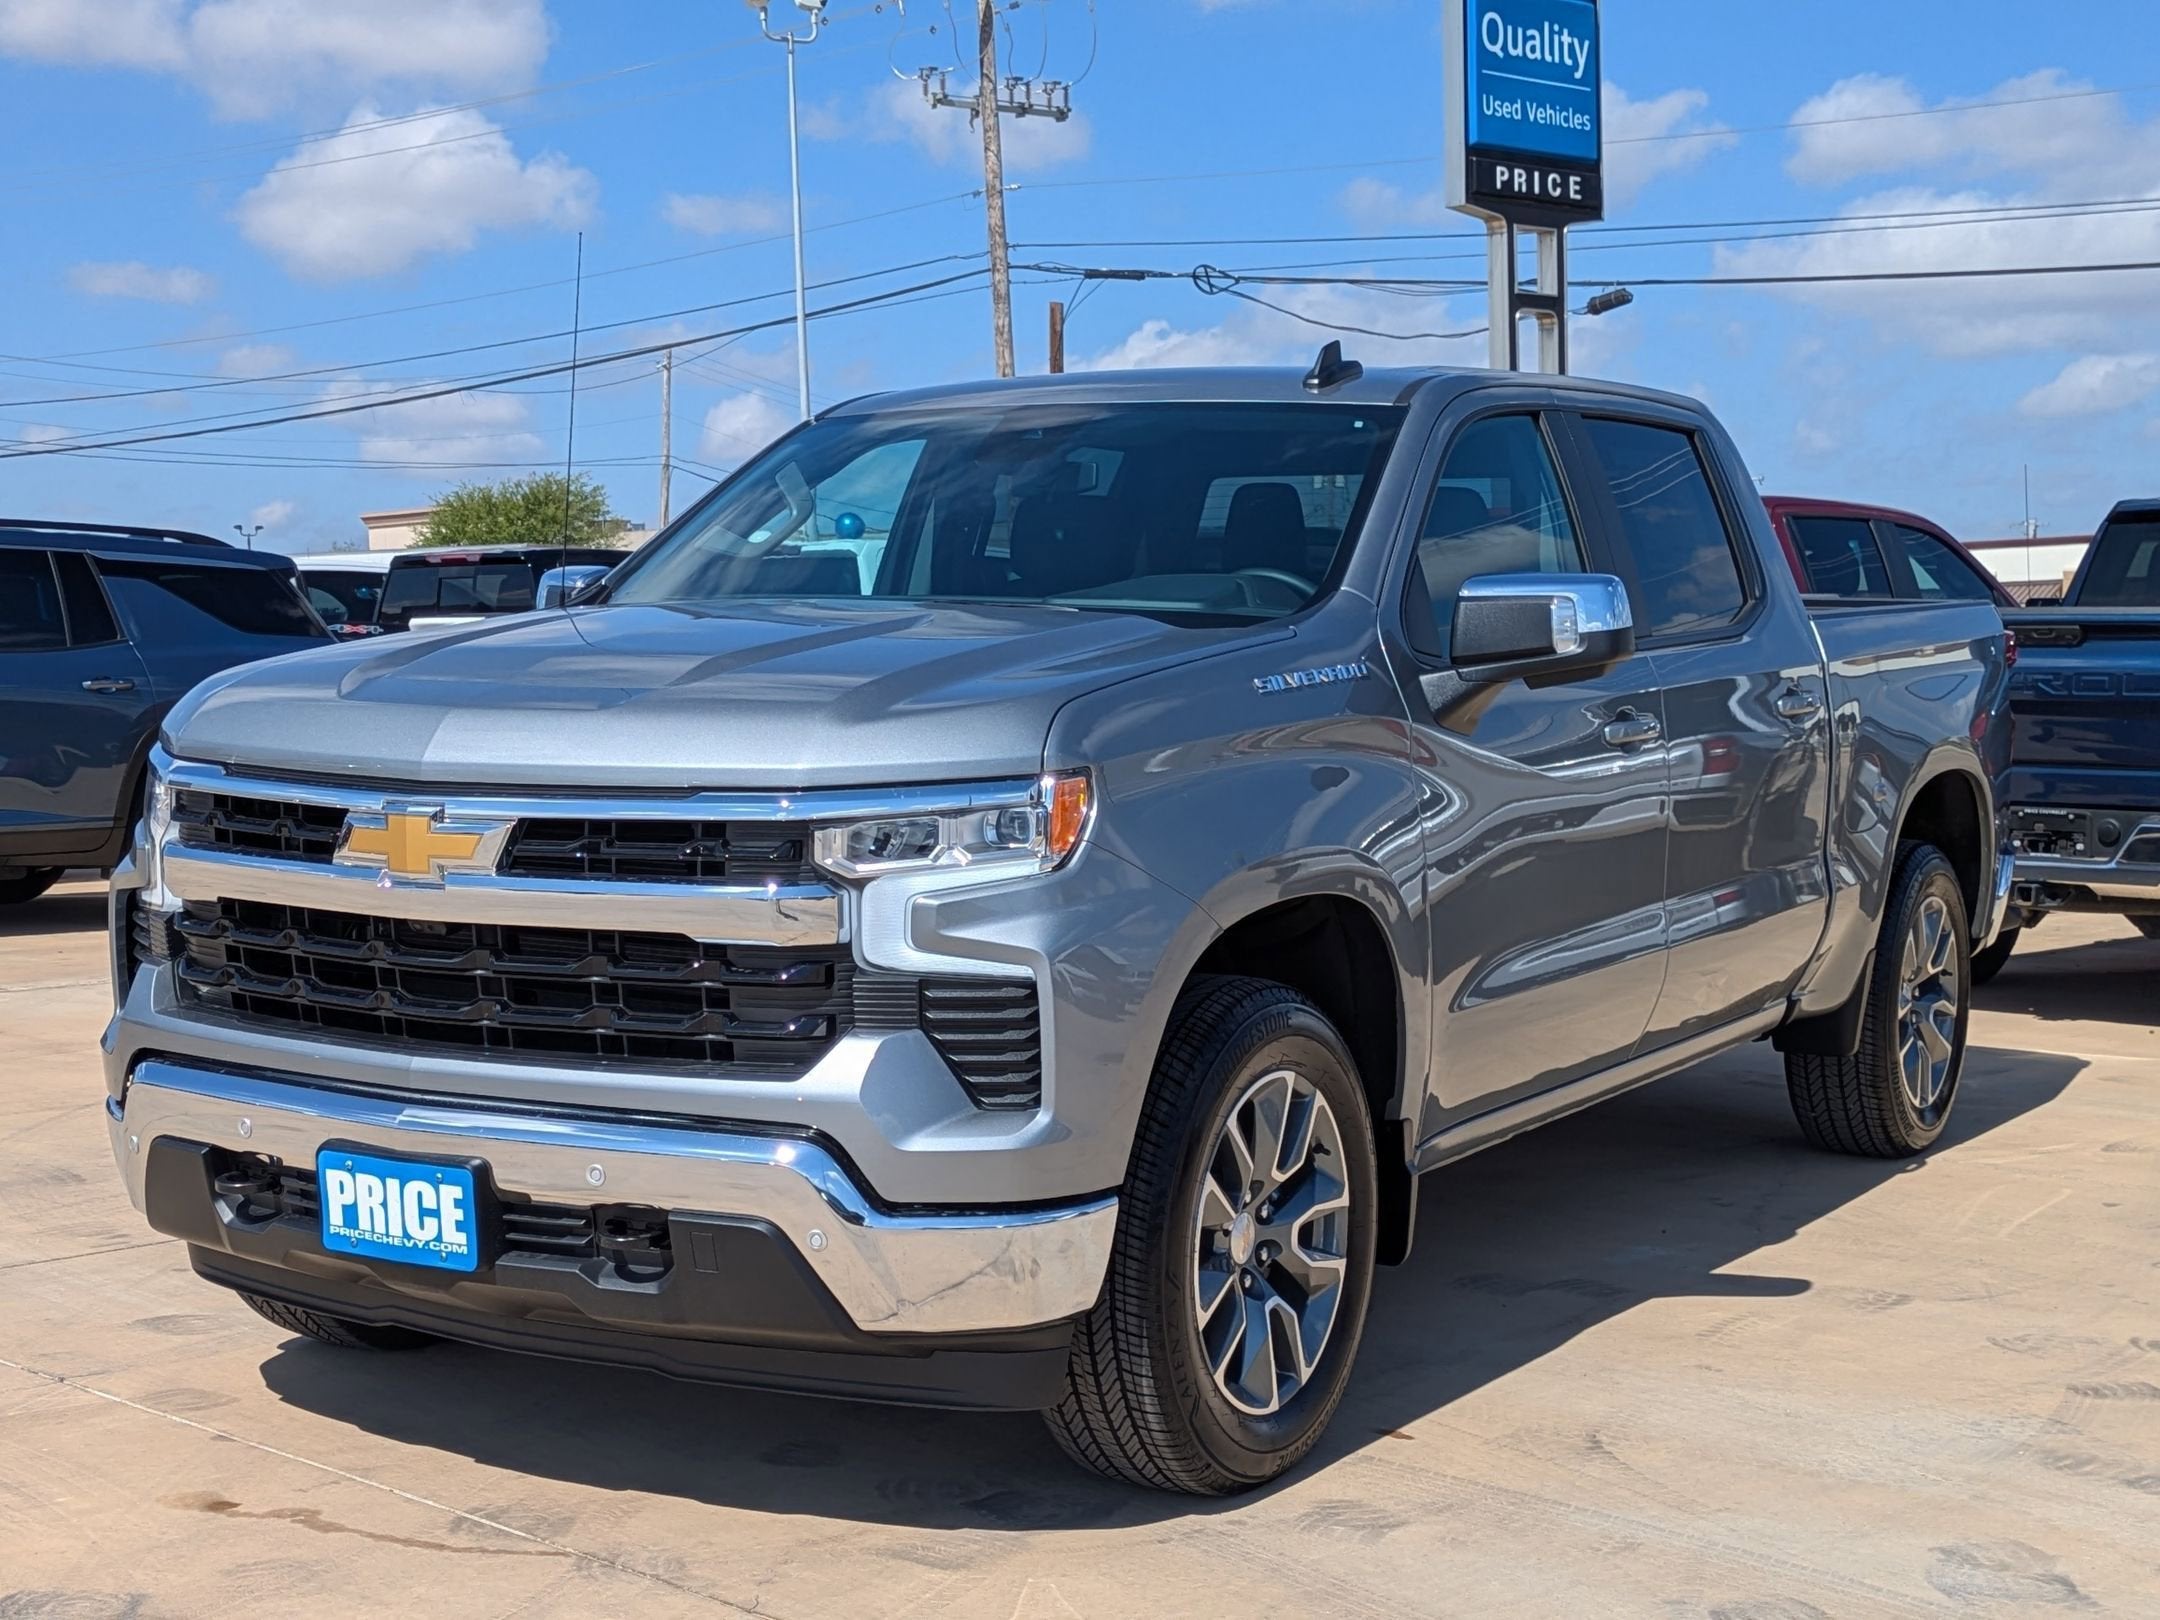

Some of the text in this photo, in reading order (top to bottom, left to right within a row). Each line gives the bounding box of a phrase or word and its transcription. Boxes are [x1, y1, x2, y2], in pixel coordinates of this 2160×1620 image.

[1482, 12, 1590, 80] Quality
[1483, 94, 1591, 131] Used Vehicles
[1496, 166, 1582, 200] PRICE
[1253, 664, 1368, 693] SILVERADO
[325, 1168, 467, 1245] PRICE
[329, 1225, 468, 1254] PRICECHEVY.COM
